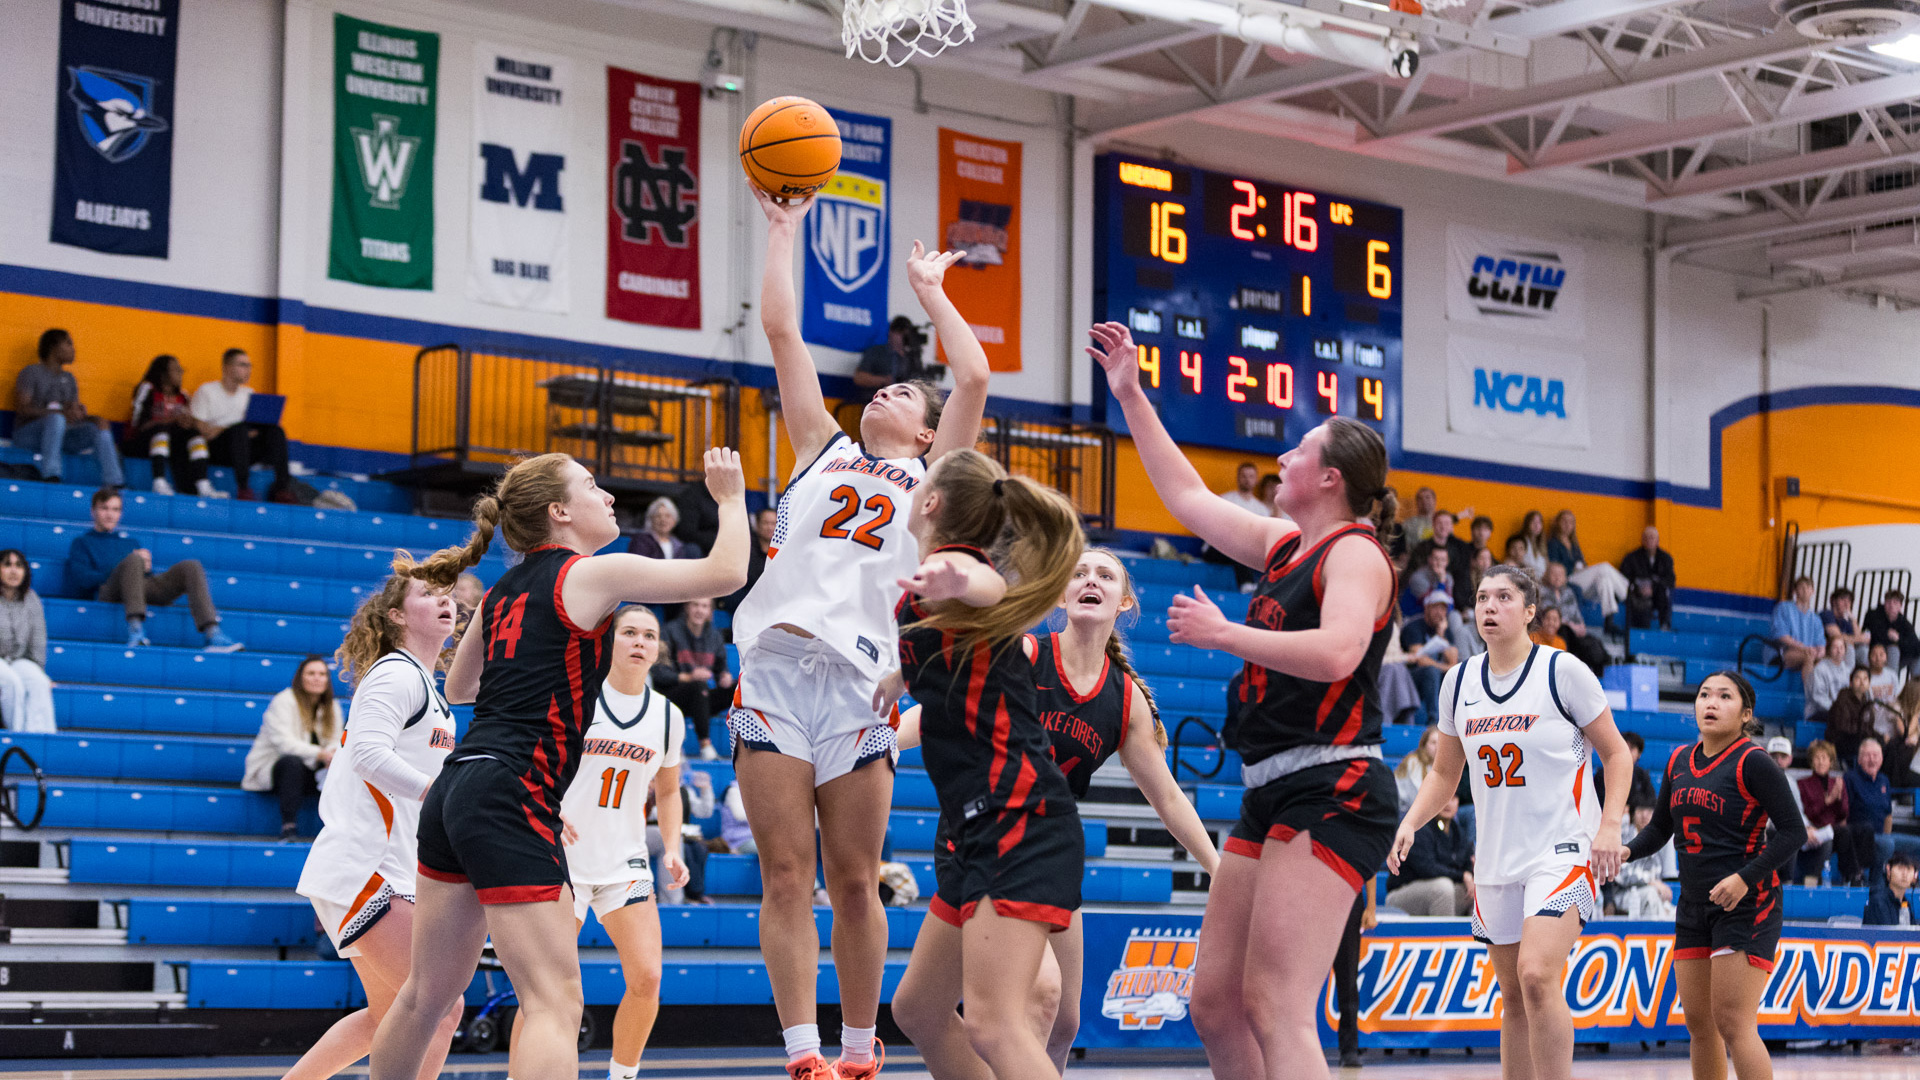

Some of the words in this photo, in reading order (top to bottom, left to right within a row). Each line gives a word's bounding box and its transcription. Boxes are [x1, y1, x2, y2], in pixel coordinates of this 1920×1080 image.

[479, 142, 565, 213] M
[820, 201, 878, 281] NP
[1150, 201, 1188, 264] 16
[1366, 239, 1392, 300] 6
[1467, 254, 1567, 311] CCIW
[1302, 275, 1311, 317] 1
[1137, 344, 1160, 389] 4
[1179, 350, 1202, 394] 4
[1317, 370, 1338, 414] 4
[1363, 377, 1383, 421] 4
[1474, 366, 1567, 420] NCAA
[819, 484, 897, 552] 22
[487, 592, 530, 662] 14
[1062, 714, 1103, 760] FOREST
[1465, 714, 1540, 738] WHEATON
[582, 738, 657, 765] WHEATON
[1477, 743, 1527, 788] 32
[598, 767, 630, 810] 11
[1686, 787, 1727, 815] FOREST
[1682, 816, 1703, 854] 5
[63, 1031, 74, 1050] A
